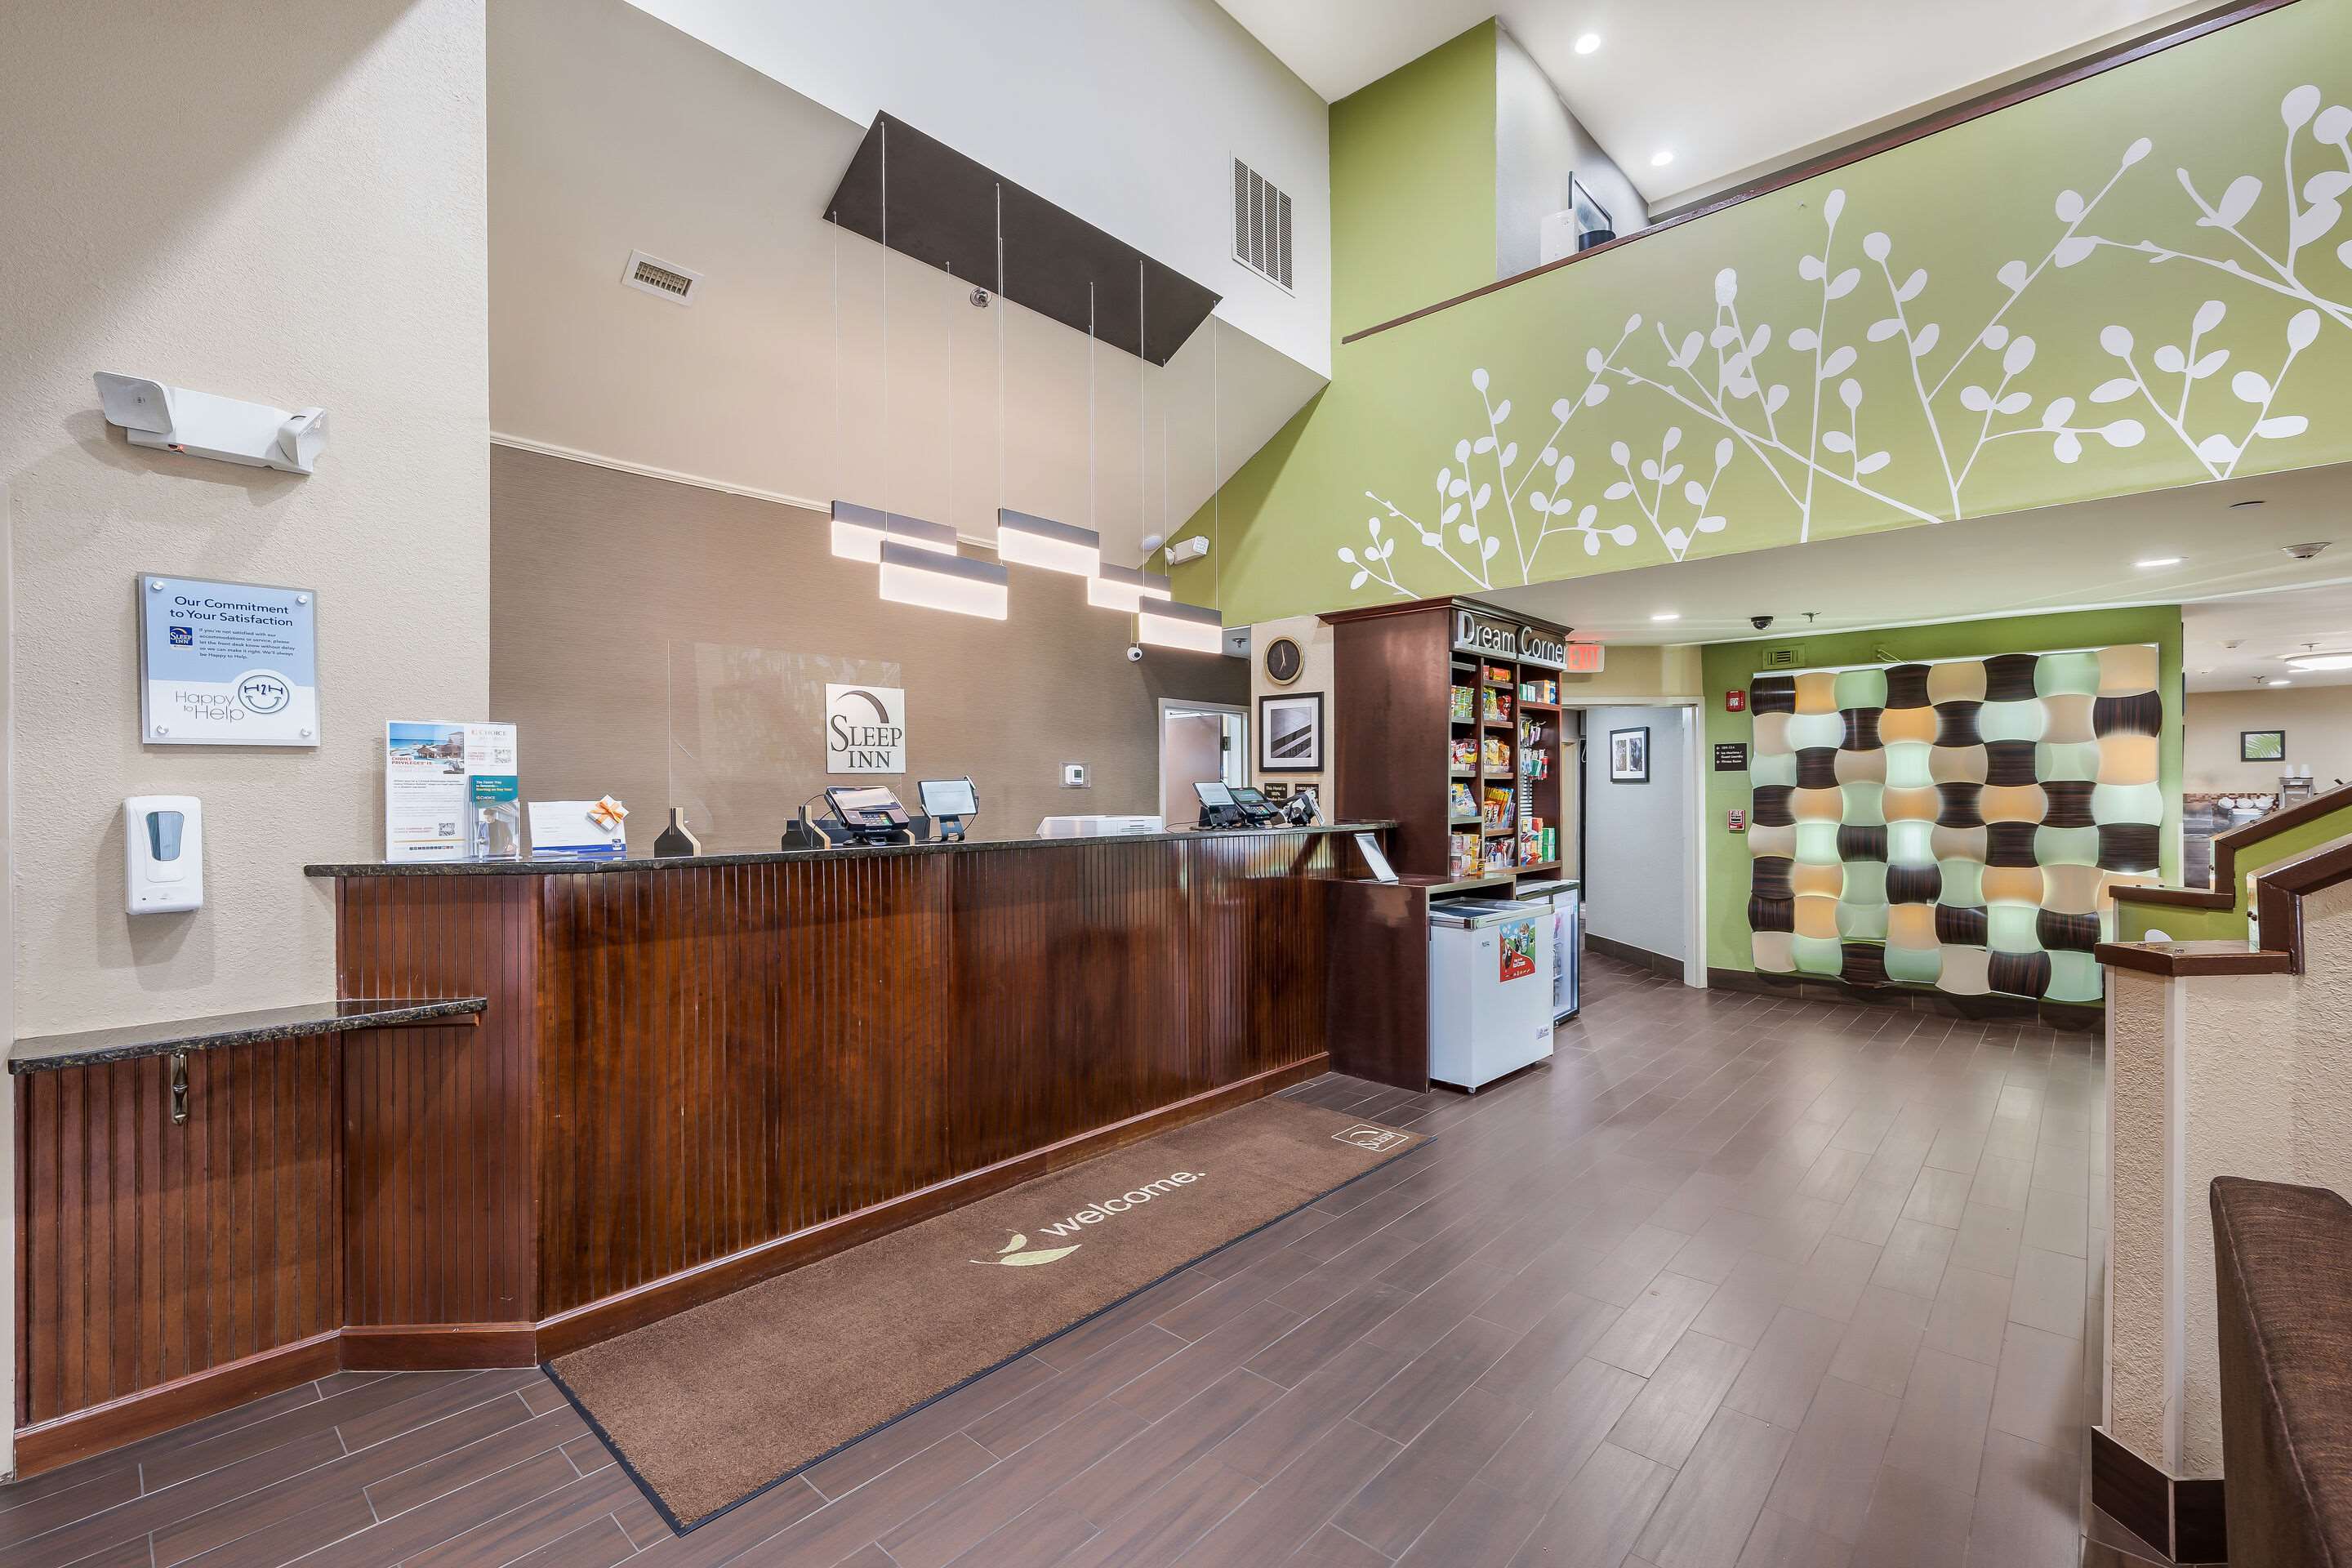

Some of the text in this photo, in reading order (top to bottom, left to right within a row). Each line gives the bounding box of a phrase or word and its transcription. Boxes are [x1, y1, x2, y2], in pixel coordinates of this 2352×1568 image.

[175, 596, 289, 614] Our Commitment
[170, 609, 293, 627] to Your Satisfaction
[170, 632, 192, 640] SLEEP
[1457, 611, 1517, 654] Dream
[1521, 626, 1567, 664] Corner
[1568, 645, 1601, 670] EXIT
[176, 691, 235, 706] Happy
[194, 705, 245, 724] Help
[830, 714, 902, 752] SLEEP
[848, 751, 892, 768] INN
[1357, 1132, 1396, 1149] SLEEP
[1039, 1169, 1207, 1238] welcome.
